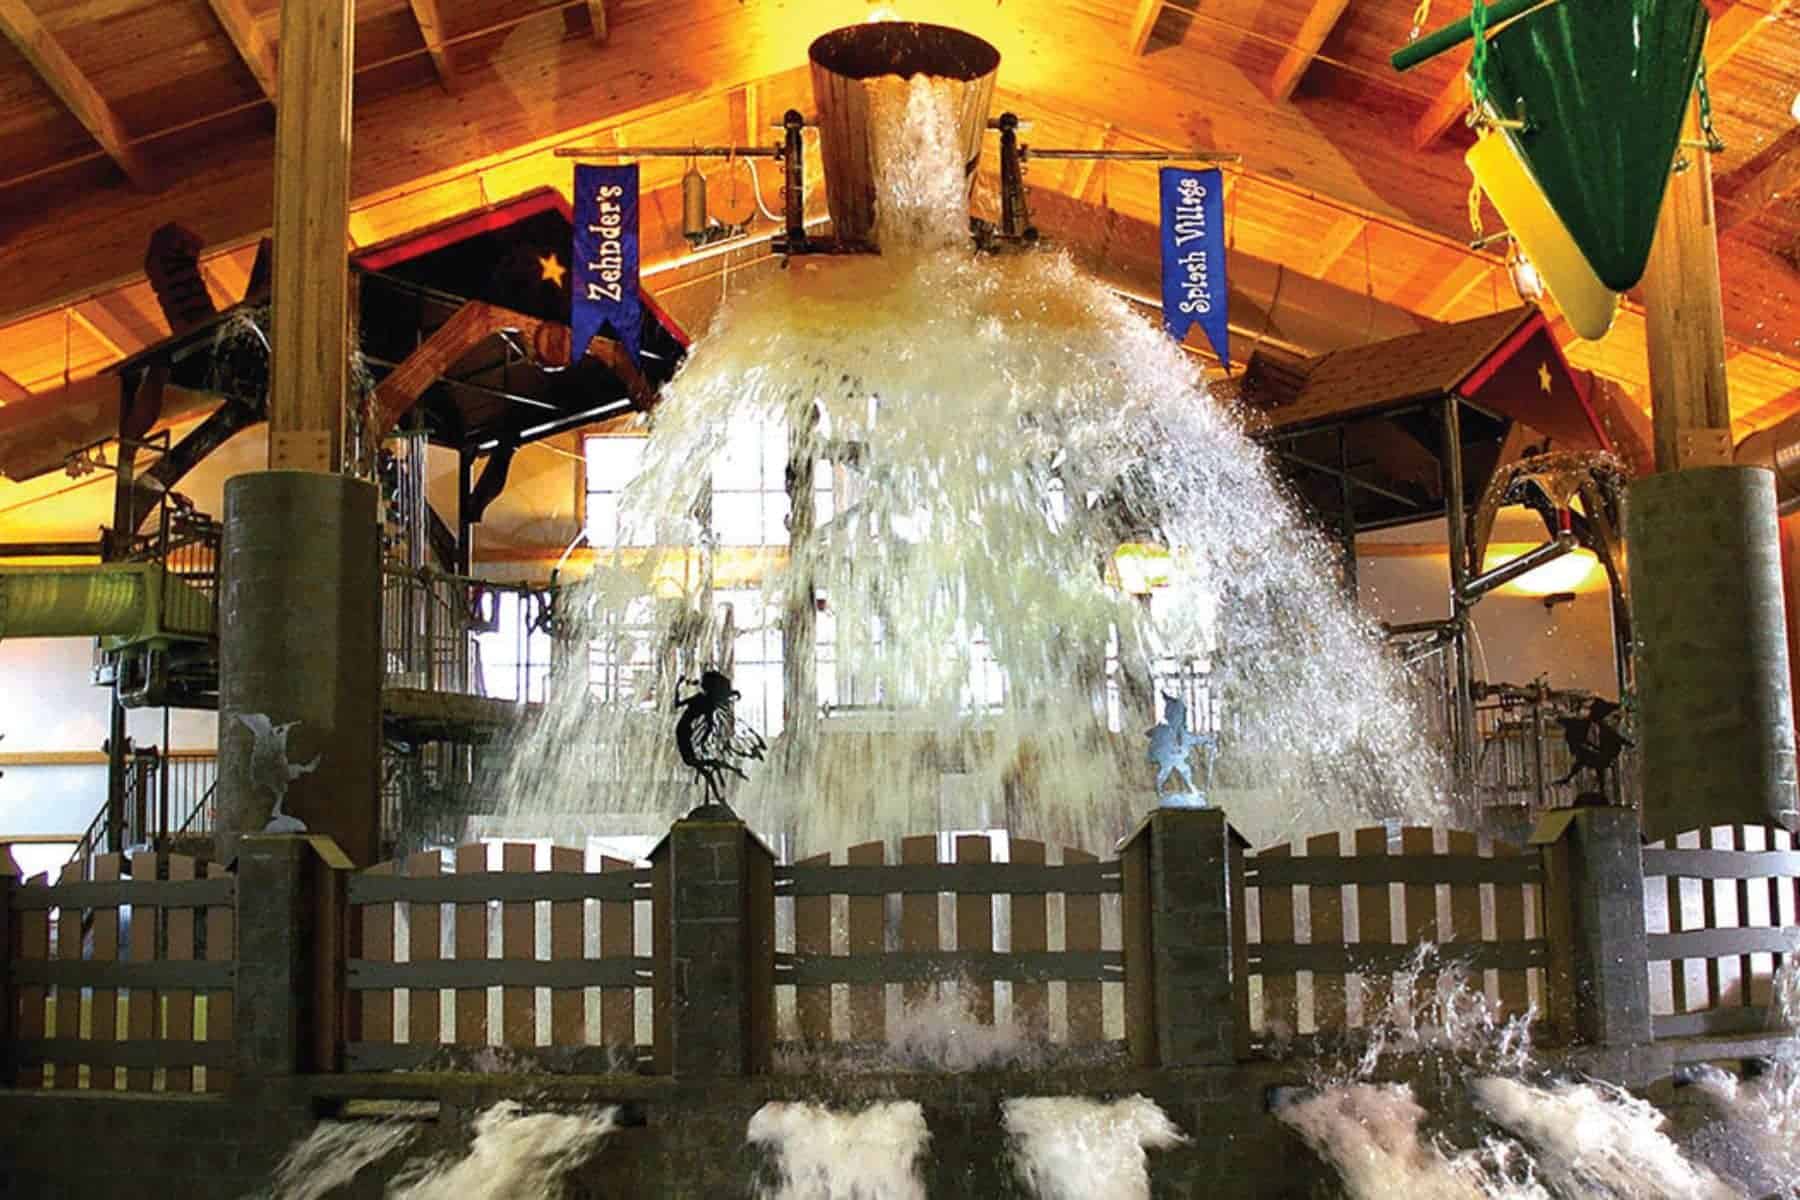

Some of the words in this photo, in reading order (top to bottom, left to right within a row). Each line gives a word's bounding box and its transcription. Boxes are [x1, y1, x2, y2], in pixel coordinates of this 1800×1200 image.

[587, 185, 623, 302] Zehnder's
[1174, 178, 1207, 247] Village
[1178, 251, 1211, 313] Splash
